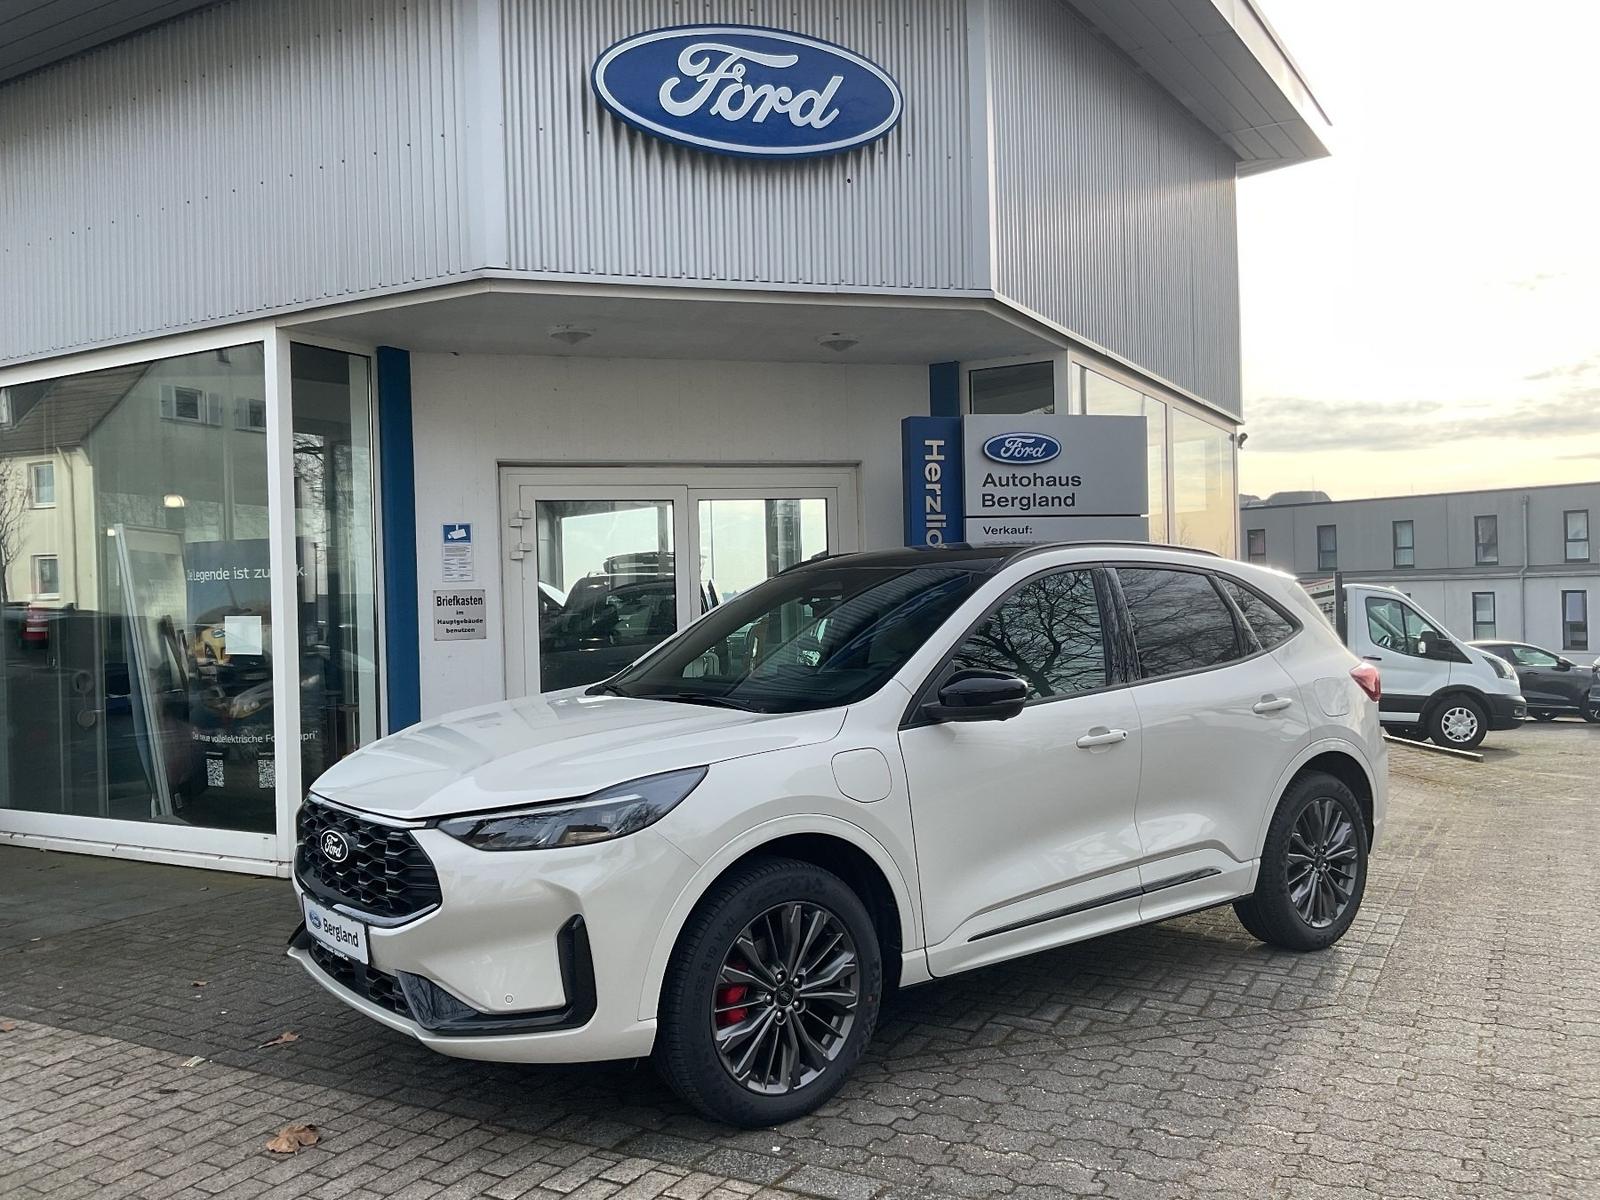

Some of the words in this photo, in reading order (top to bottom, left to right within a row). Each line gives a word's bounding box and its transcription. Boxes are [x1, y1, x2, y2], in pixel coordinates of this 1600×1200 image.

[659, 42, 844, 129] Ford
[1000, 437, 1046, 458] Ford
[982, 472, 1082, 488] Autohaus
[924, 440, 947, 549] Herzlic
[981, 492, 1076, 511] Bergland
[982, 525, 1033, 535] Verkauf:
[233, 566, 249, 580] ist
[436, 595, 483, 606] Briefkasten
[437, 617, 483, 625] Hauptgebäude
[324, 834, 343, 858] Ford
[323, 917, 359, 948] Bergland
